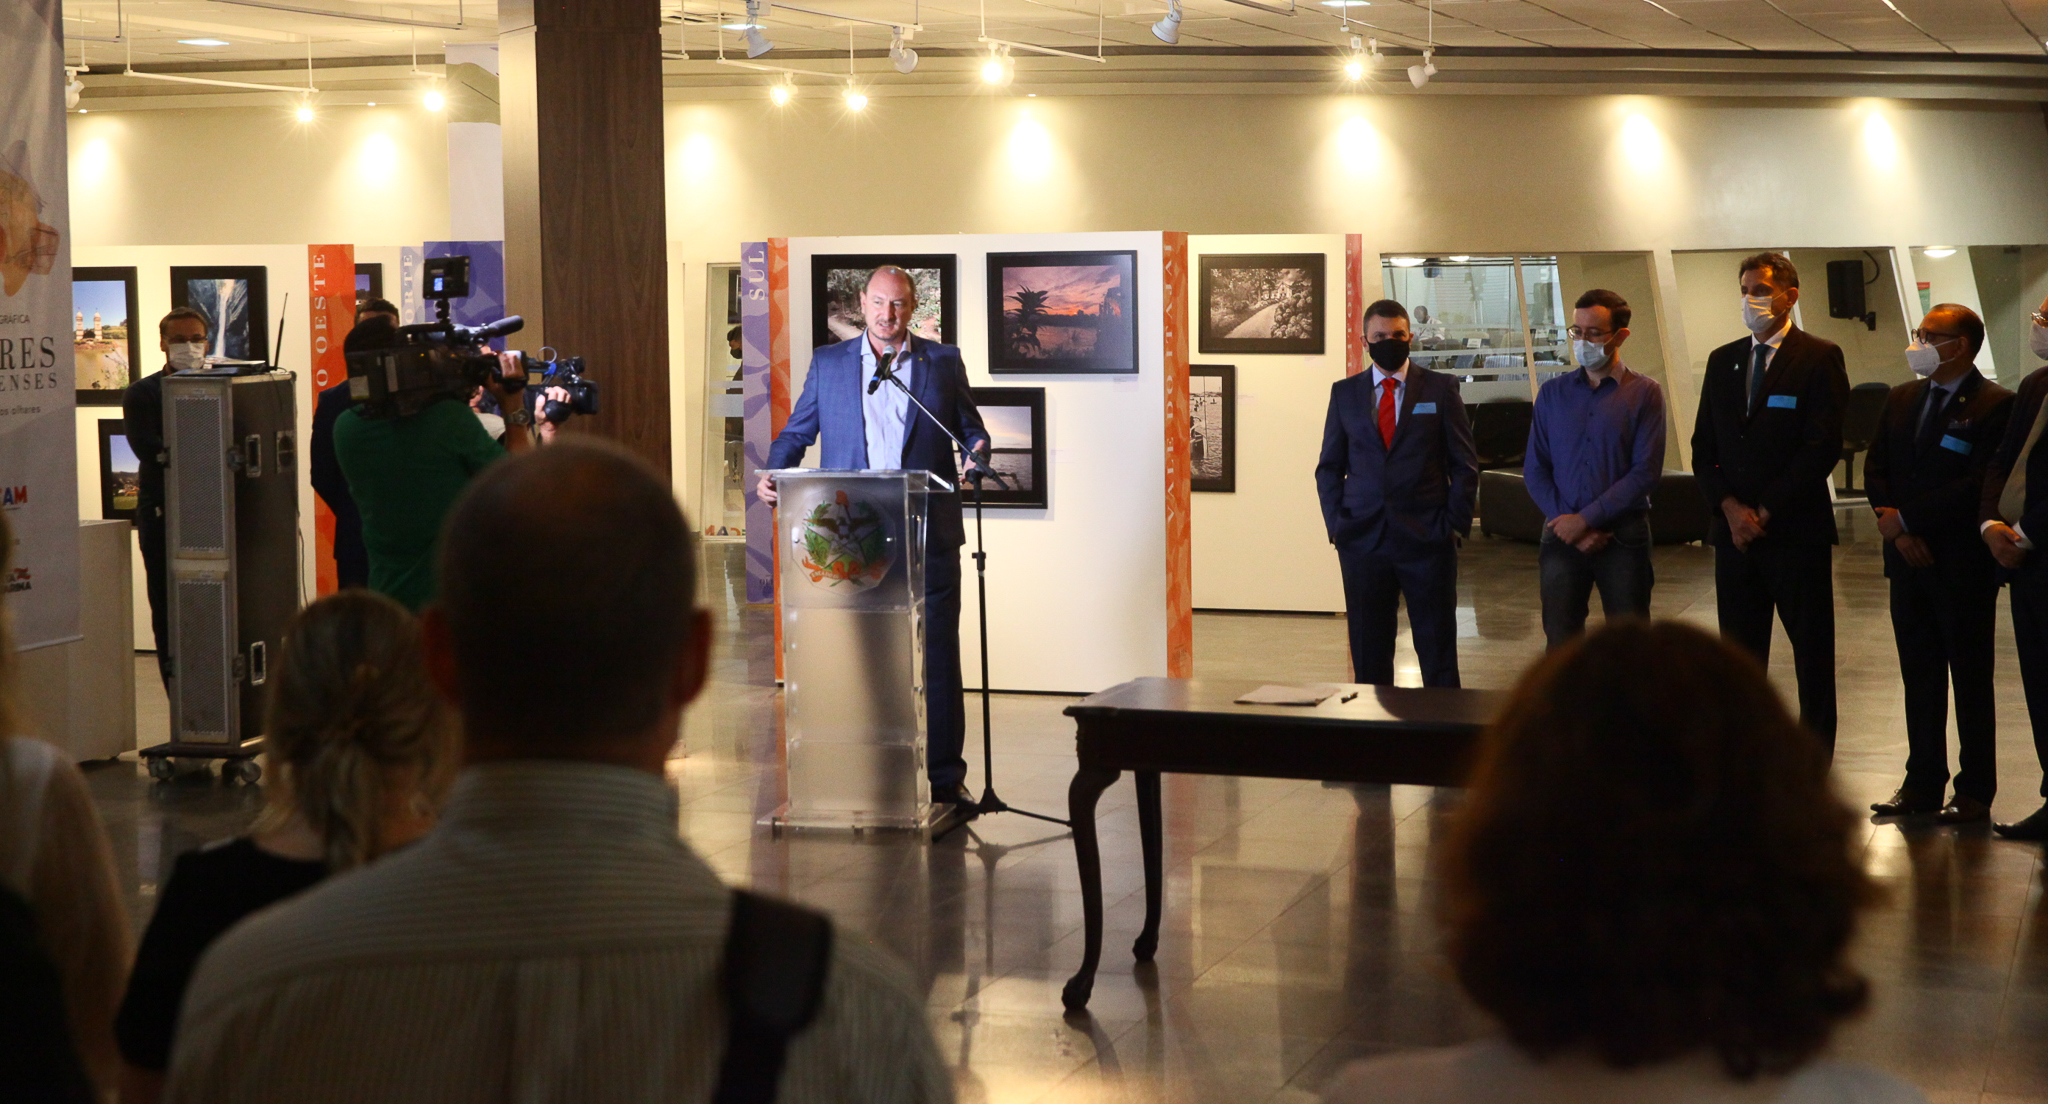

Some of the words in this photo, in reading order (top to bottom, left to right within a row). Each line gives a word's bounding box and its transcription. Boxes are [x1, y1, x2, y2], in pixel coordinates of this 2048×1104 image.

[313, 254, 328, 354] OESTE
[404, 255, 415, 323] ORTE
[748, 250, 765, 301] SUL
[1166, 375, 1174, 419] DO
[1166, 436, 1175, 523] VALE
